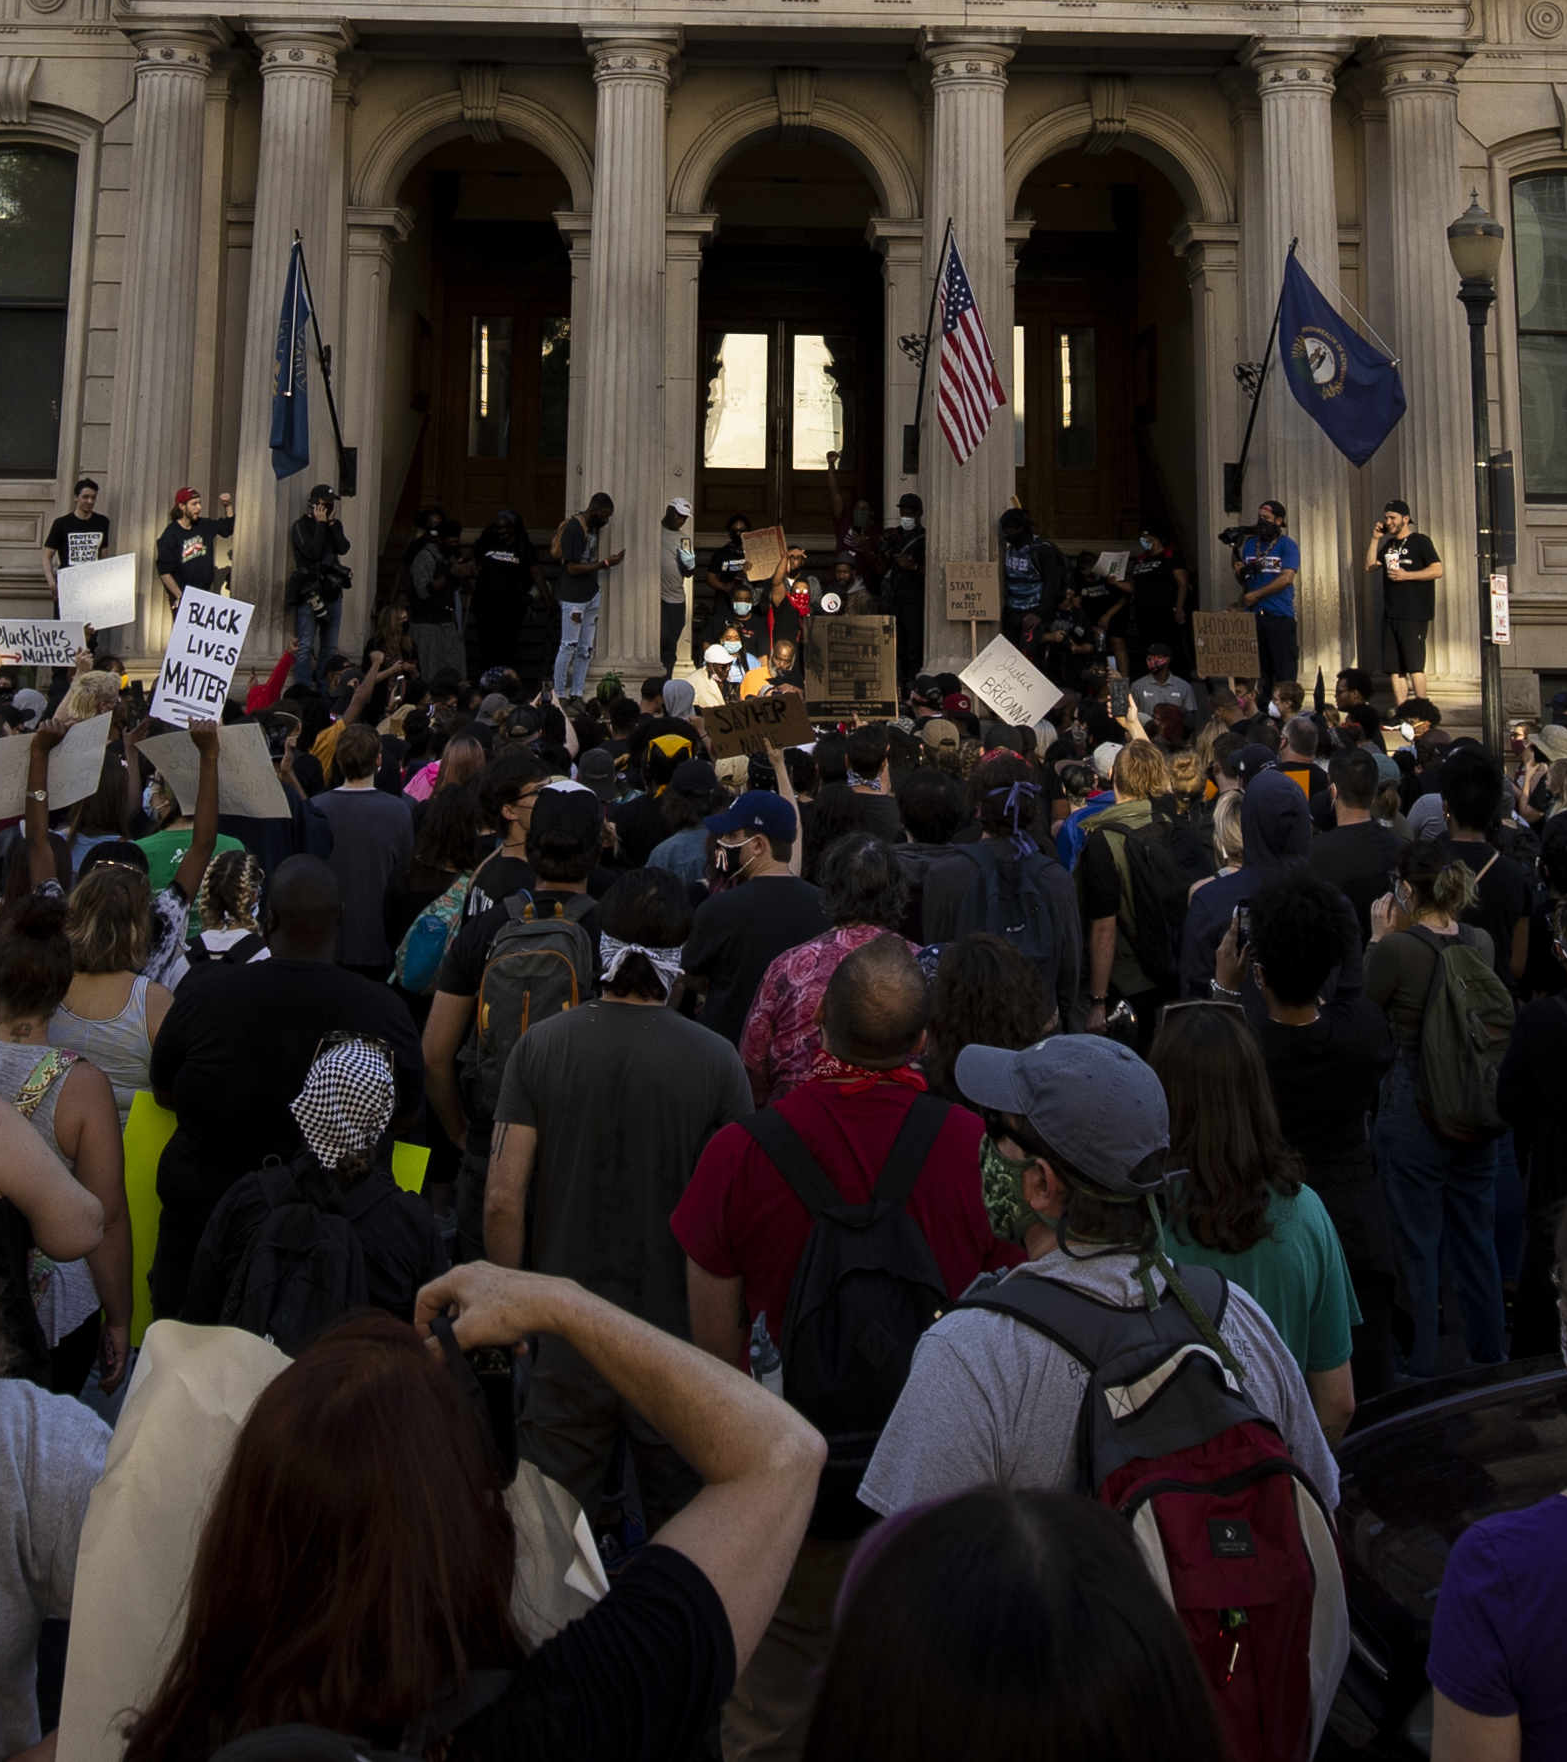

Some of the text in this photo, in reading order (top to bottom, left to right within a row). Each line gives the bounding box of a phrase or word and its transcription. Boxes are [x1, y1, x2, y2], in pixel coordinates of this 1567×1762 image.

[950, 582, 974, 591] STATE
[965, 593, 983, 601] NOT
[188, 601, 243, 636] BLACK
[951, 601, 975, 609] POLICE
[32, 625, 71, 649] Lives
[1197, 617, 1249, 635] WHO DO YOU
[186, 634, 239, 667] LIVES
[162, 657, 228, 705] MATTER
[995, 655, 1036, 693] Justice
[714, 698, 788, 735] SAY HER
[980, 676, 1034, 728] BREONNA
